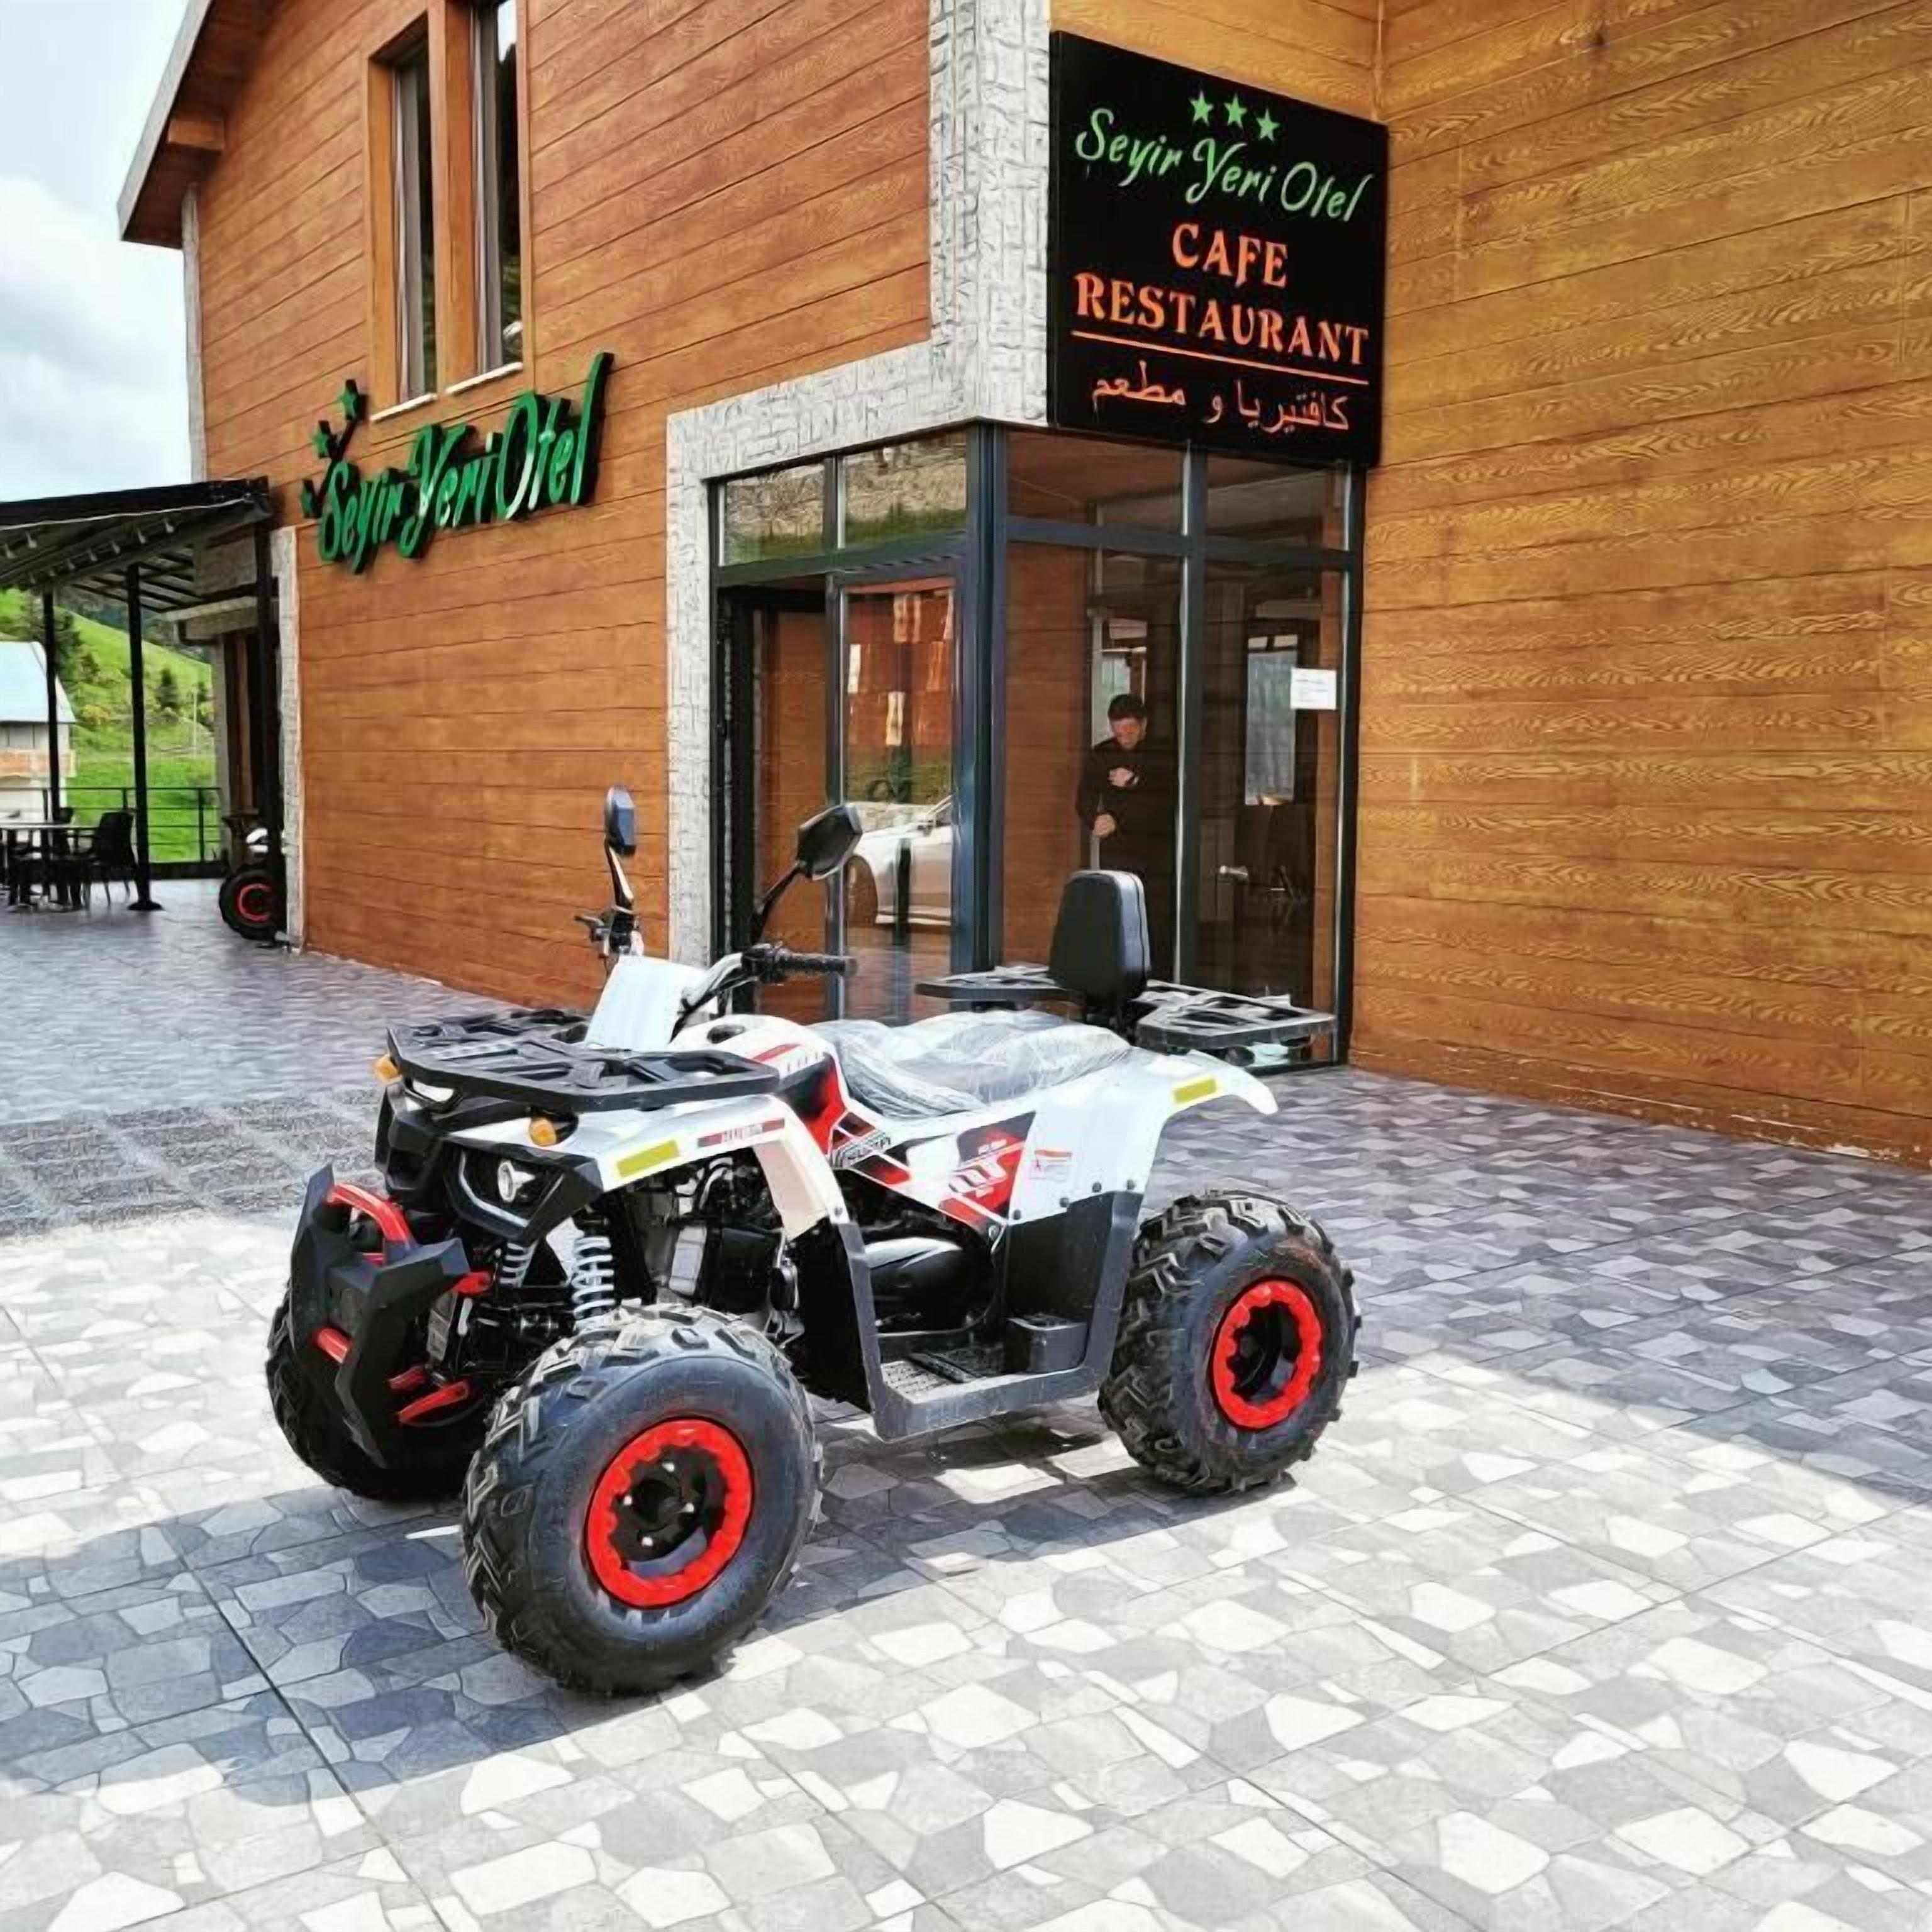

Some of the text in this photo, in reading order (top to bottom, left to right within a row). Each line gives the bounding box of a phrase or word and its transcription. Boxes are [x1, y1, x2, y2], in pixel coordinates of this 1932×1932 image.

[1075, 108, 1183, 187] Seyir
[1185, 137, 1277, 204] Yeri
[1172, 223, 1288, 288] CAFE
[1074, 272, 1369, 365] RESTAURANT
[1092, 359, 1350, 434] كافتيريا و مطعم
[318, 460, 409, 575] Seyir
[496, 352, 610, 521] Otel
